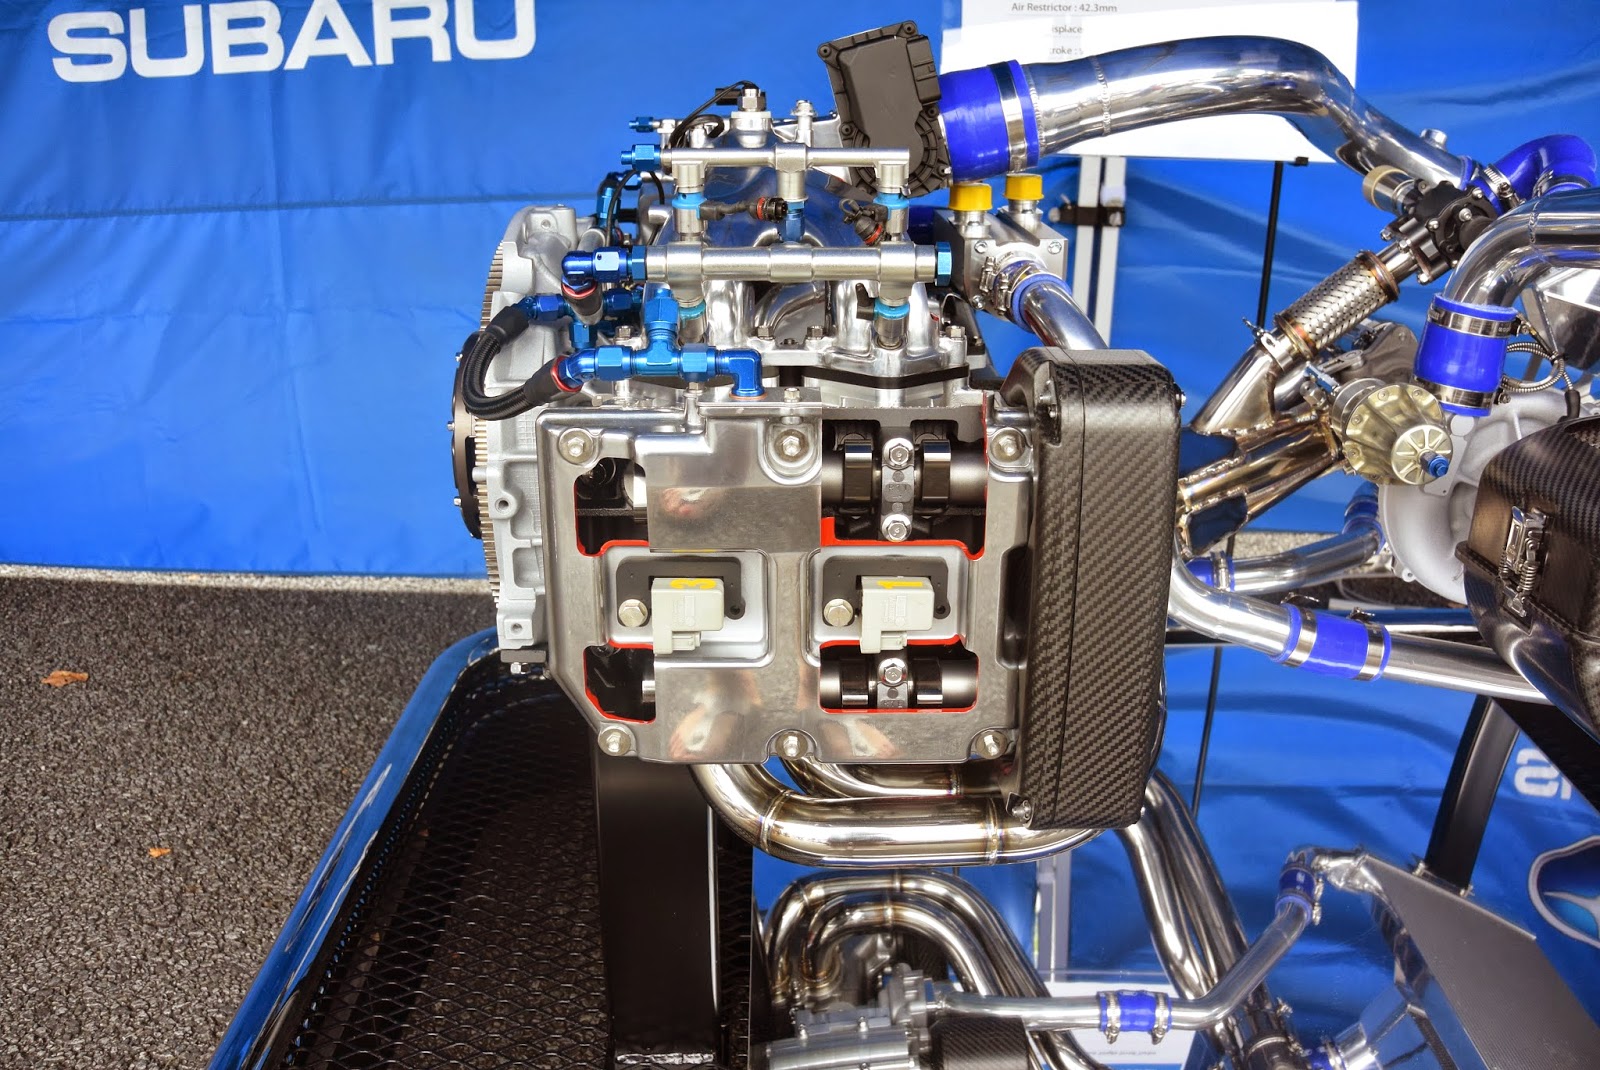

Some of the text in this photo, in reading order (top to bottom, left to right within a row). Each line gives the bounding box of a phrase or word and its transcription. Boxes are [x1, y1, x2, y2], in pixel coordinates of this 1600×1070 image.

[1011, 3, 1025, 11] Air
[1027, 3, 1072, 12] Restrictor
[1079, 3, 1118, 13] 42.3mm
[47, 0, 536, 83] SUBARU
